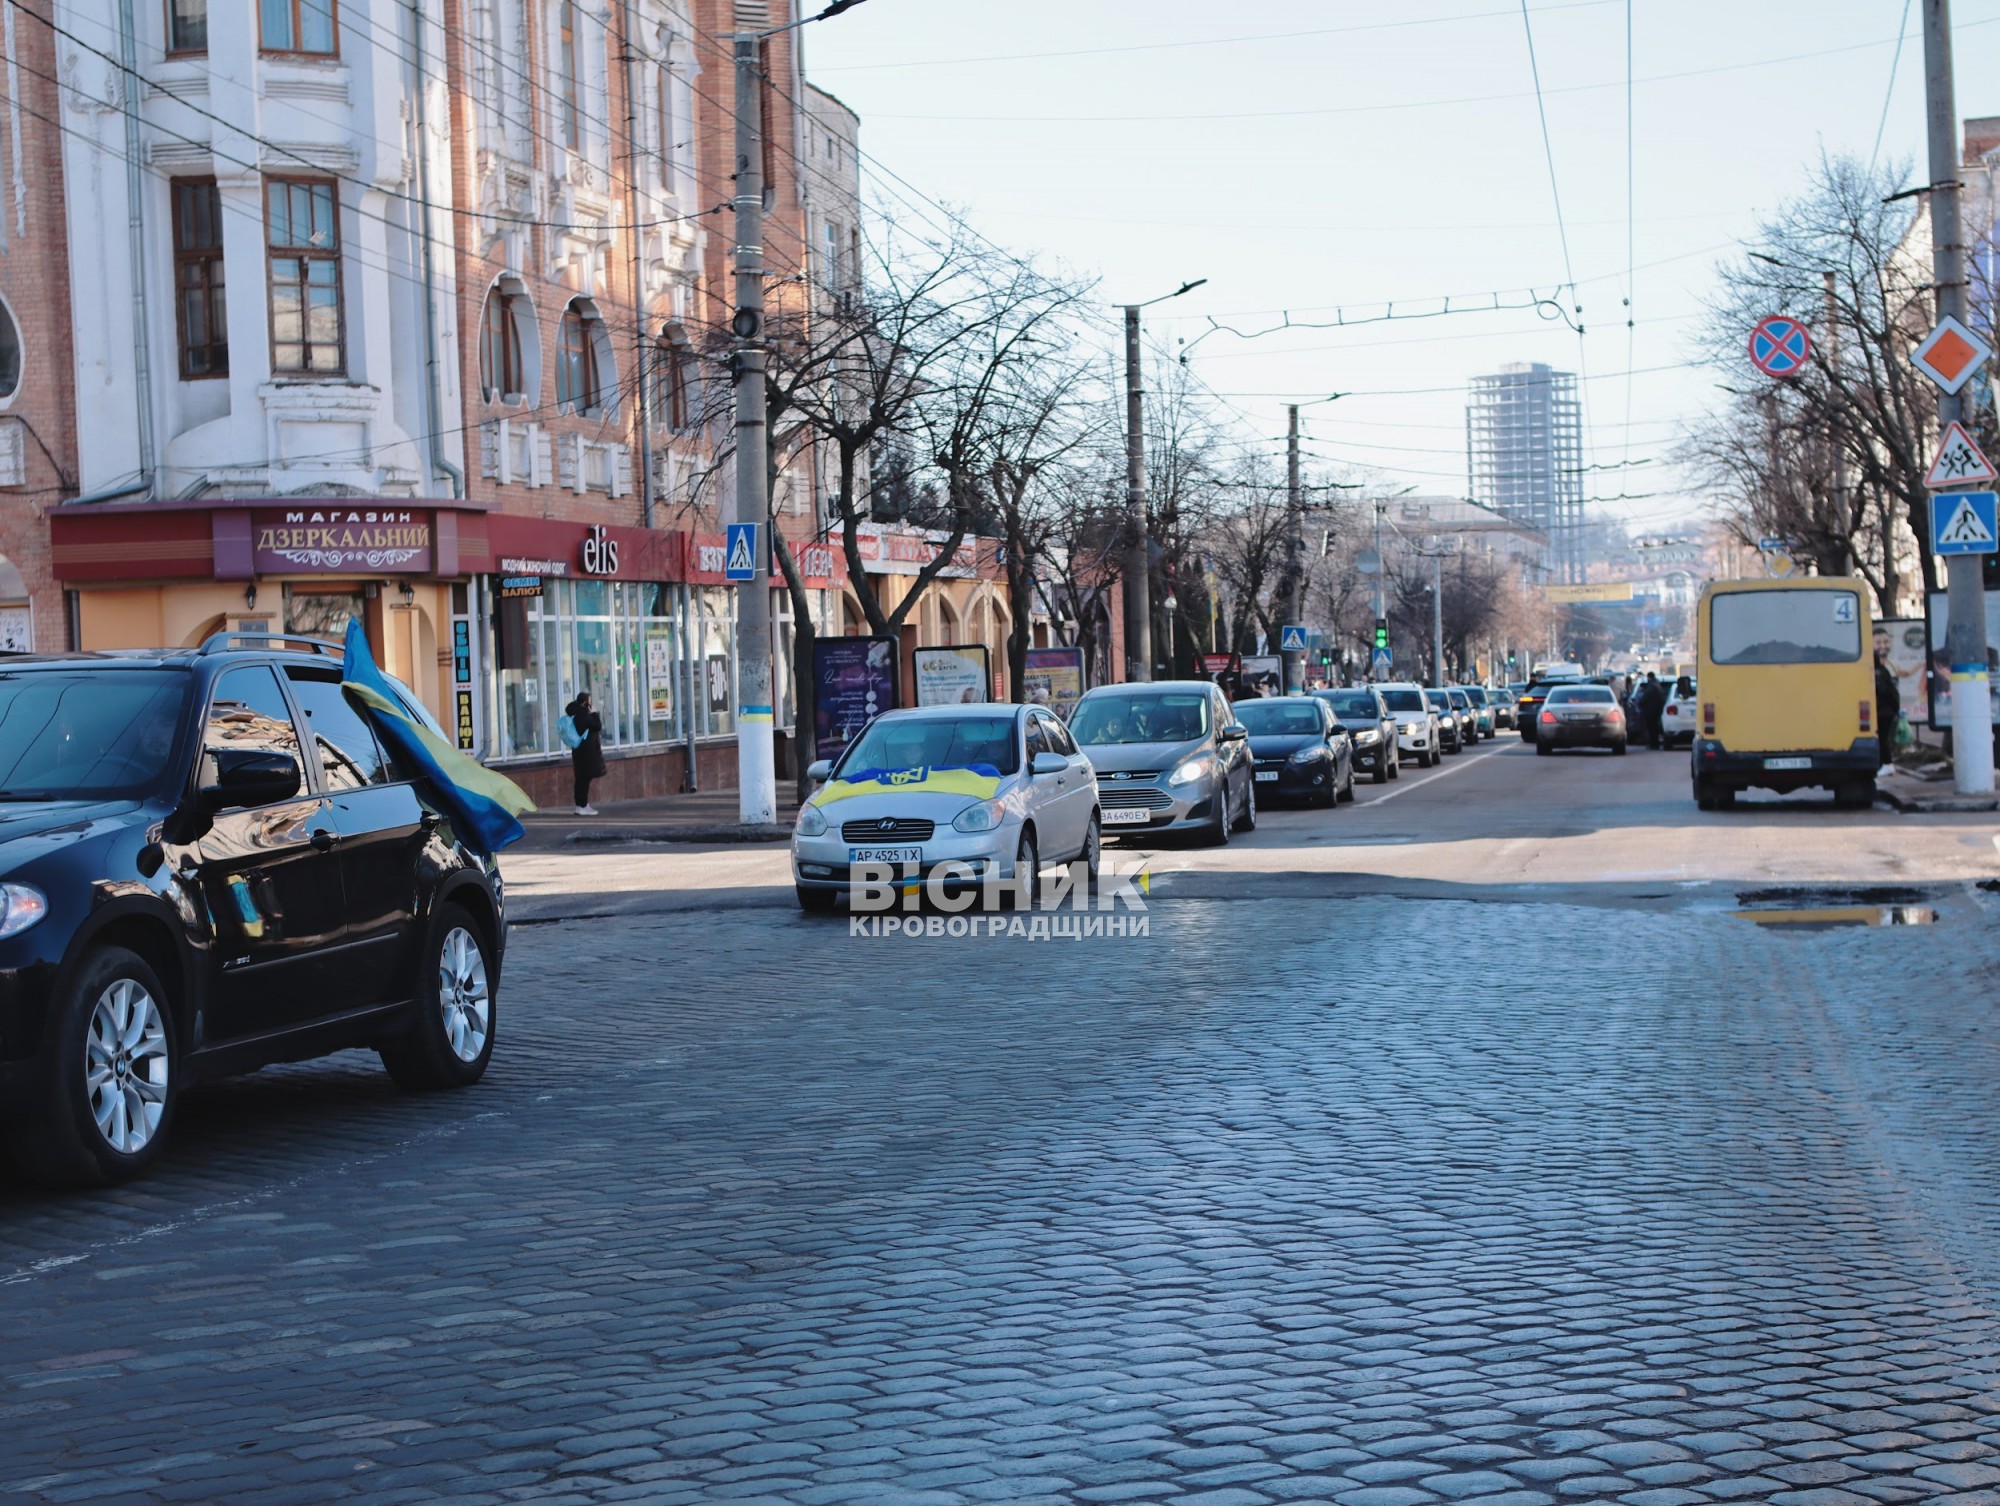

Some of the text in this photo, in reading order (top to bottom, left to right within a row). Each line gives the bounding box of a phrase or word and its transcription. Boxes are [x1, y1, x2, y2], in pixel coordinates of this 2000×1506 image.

[286, 512, 411, 523] МАГАЗИН
[257, 524, 430, 551] ДЗЕРКАЛЬНИЙ
[584, 524, 618, 575] elis
[502, 587, 541, 597] ВАЛЮТ
[503, 577, 540, 588] ОБМІН
[1837, 600, 1850, 619] 4
[456, 622, 469, 681] ОБМІН
[459, 694, 472, 748] ВАЛЮТ
[875, 850, 899, 861] 4525
